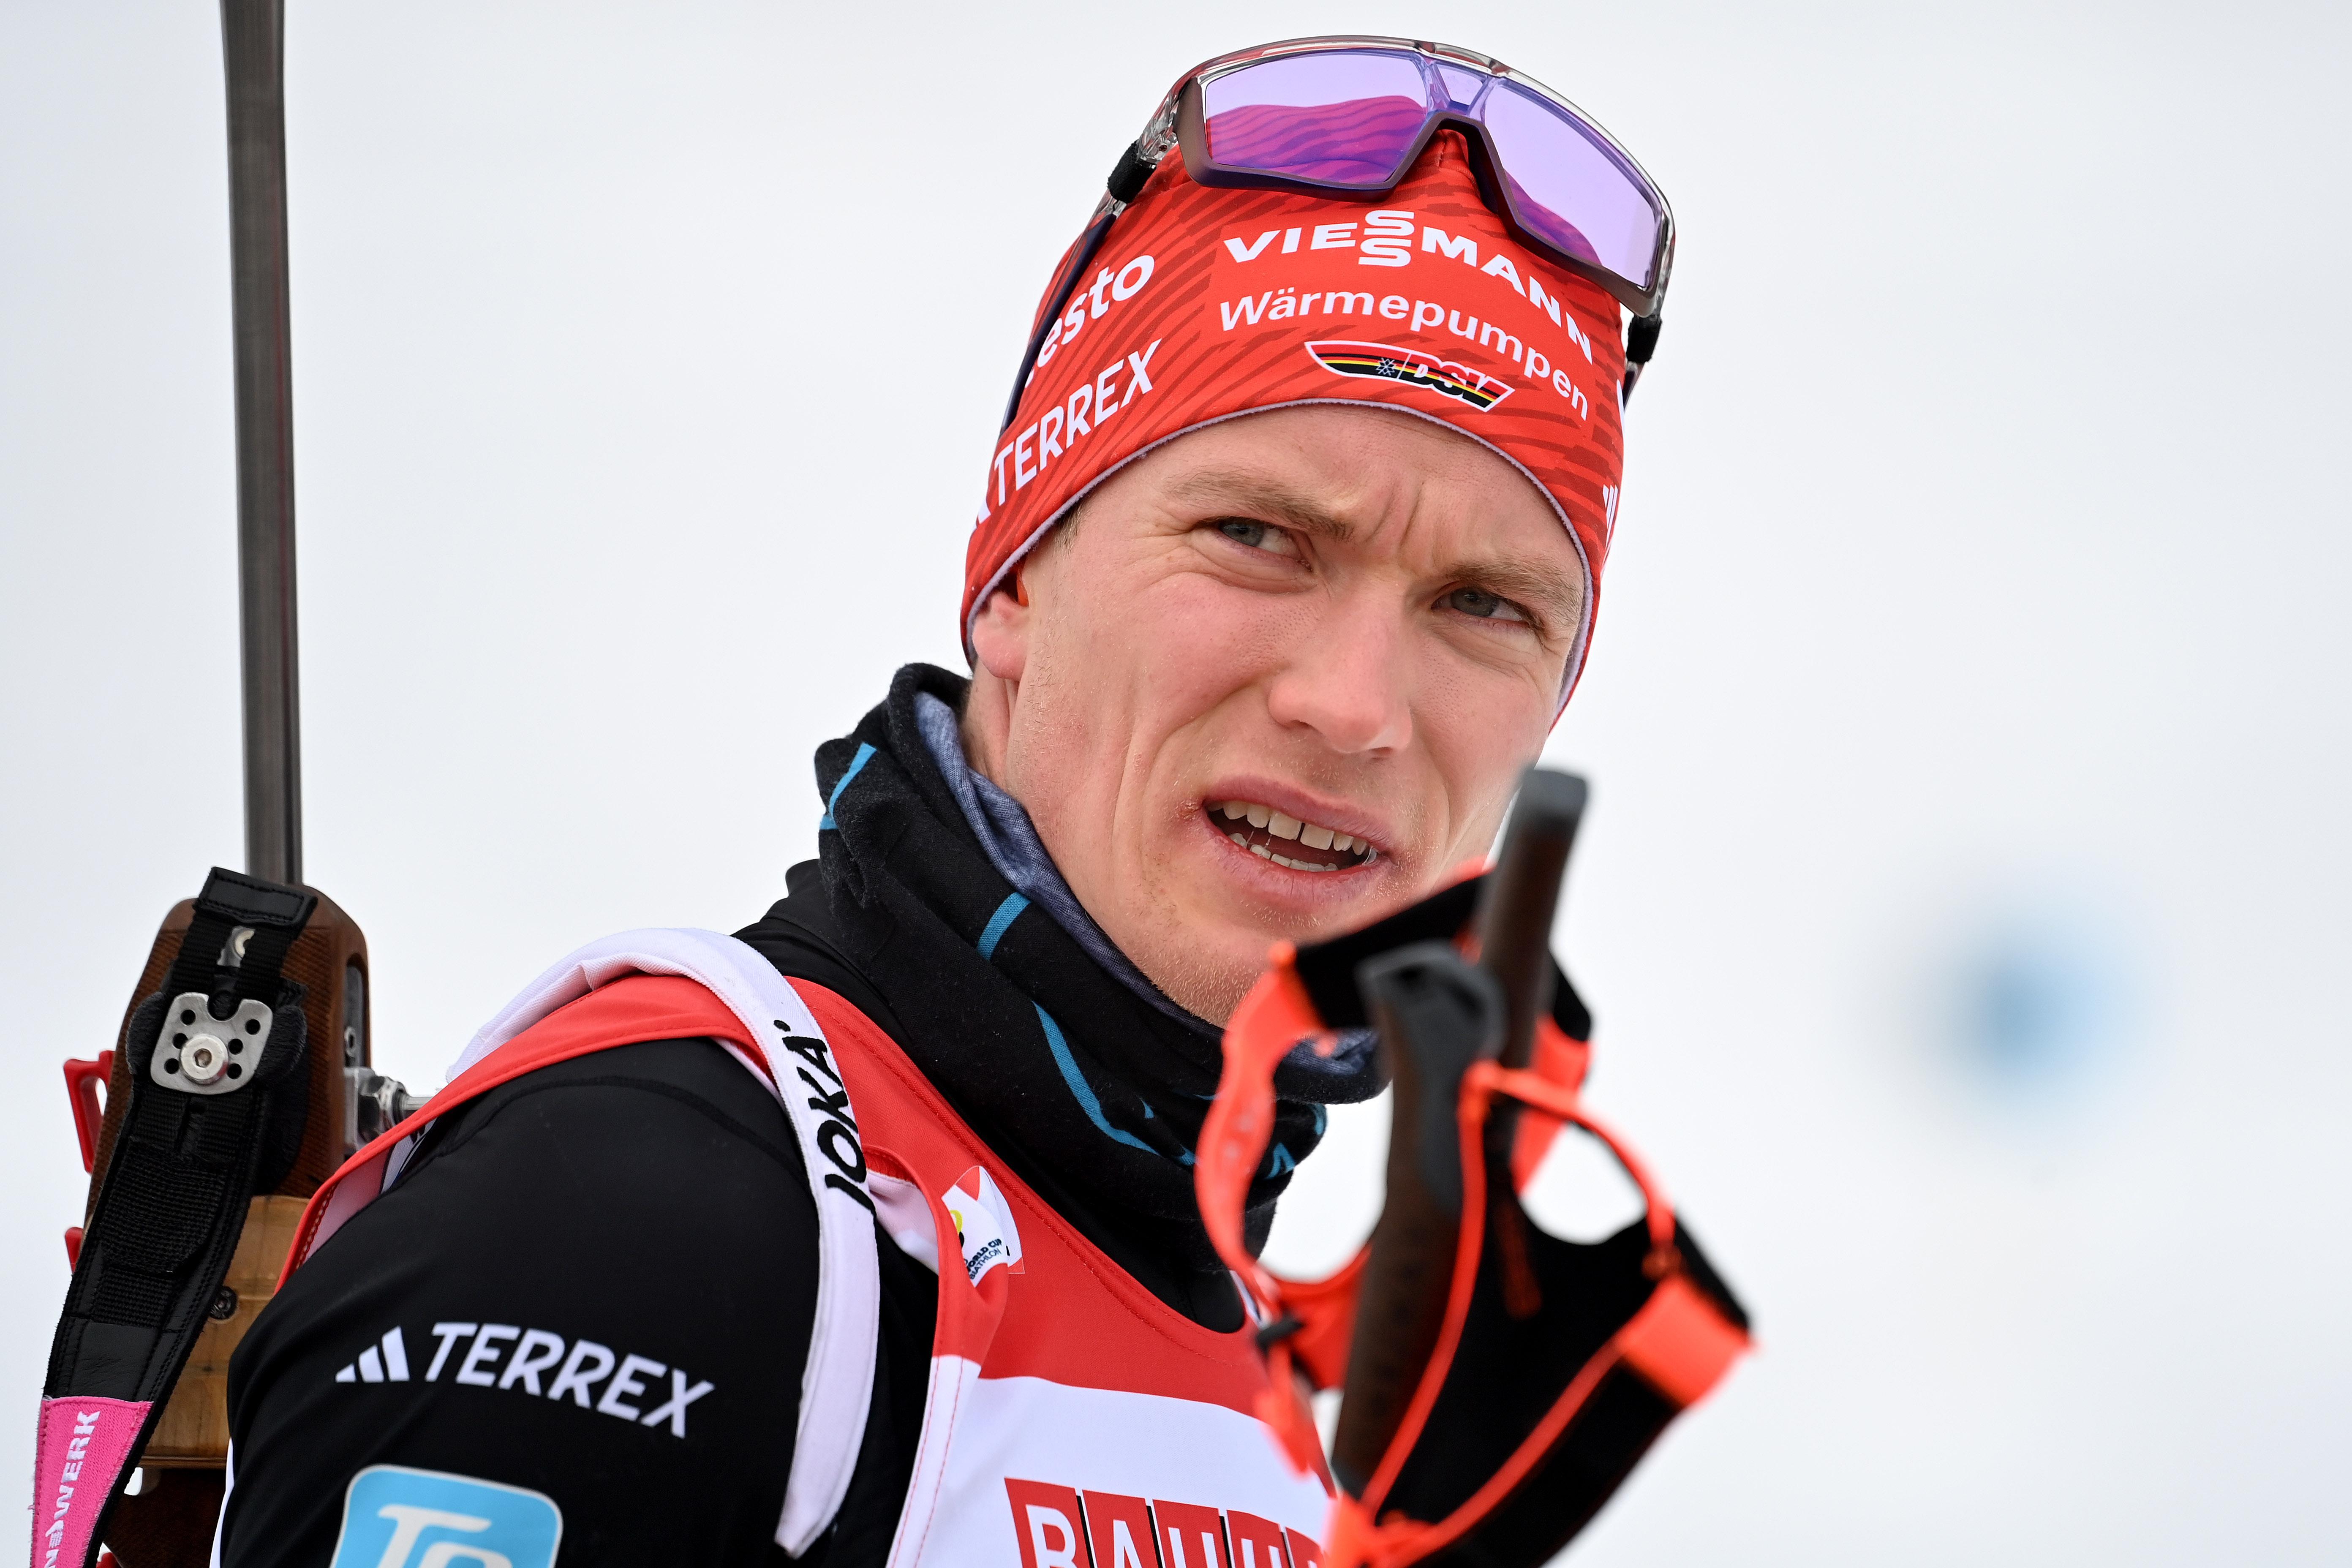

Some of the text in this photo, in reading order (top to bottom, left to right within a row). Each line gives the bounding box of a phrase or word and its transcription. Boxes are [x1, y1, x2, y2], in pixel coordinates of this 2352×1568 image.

[1024, 255, 1154, 388] esto
[1220, 287, 1590, 421] Wärmepumpen
[1223, 210, 1593, 366] VIESSMANN
[994, 338, 1162, 506] TERREX
[1397, 353, 1516, 412] DSV
[969, 1248, 1002, 1279] BIATHLON
[426, 1322, 715, 1438] TERREX
